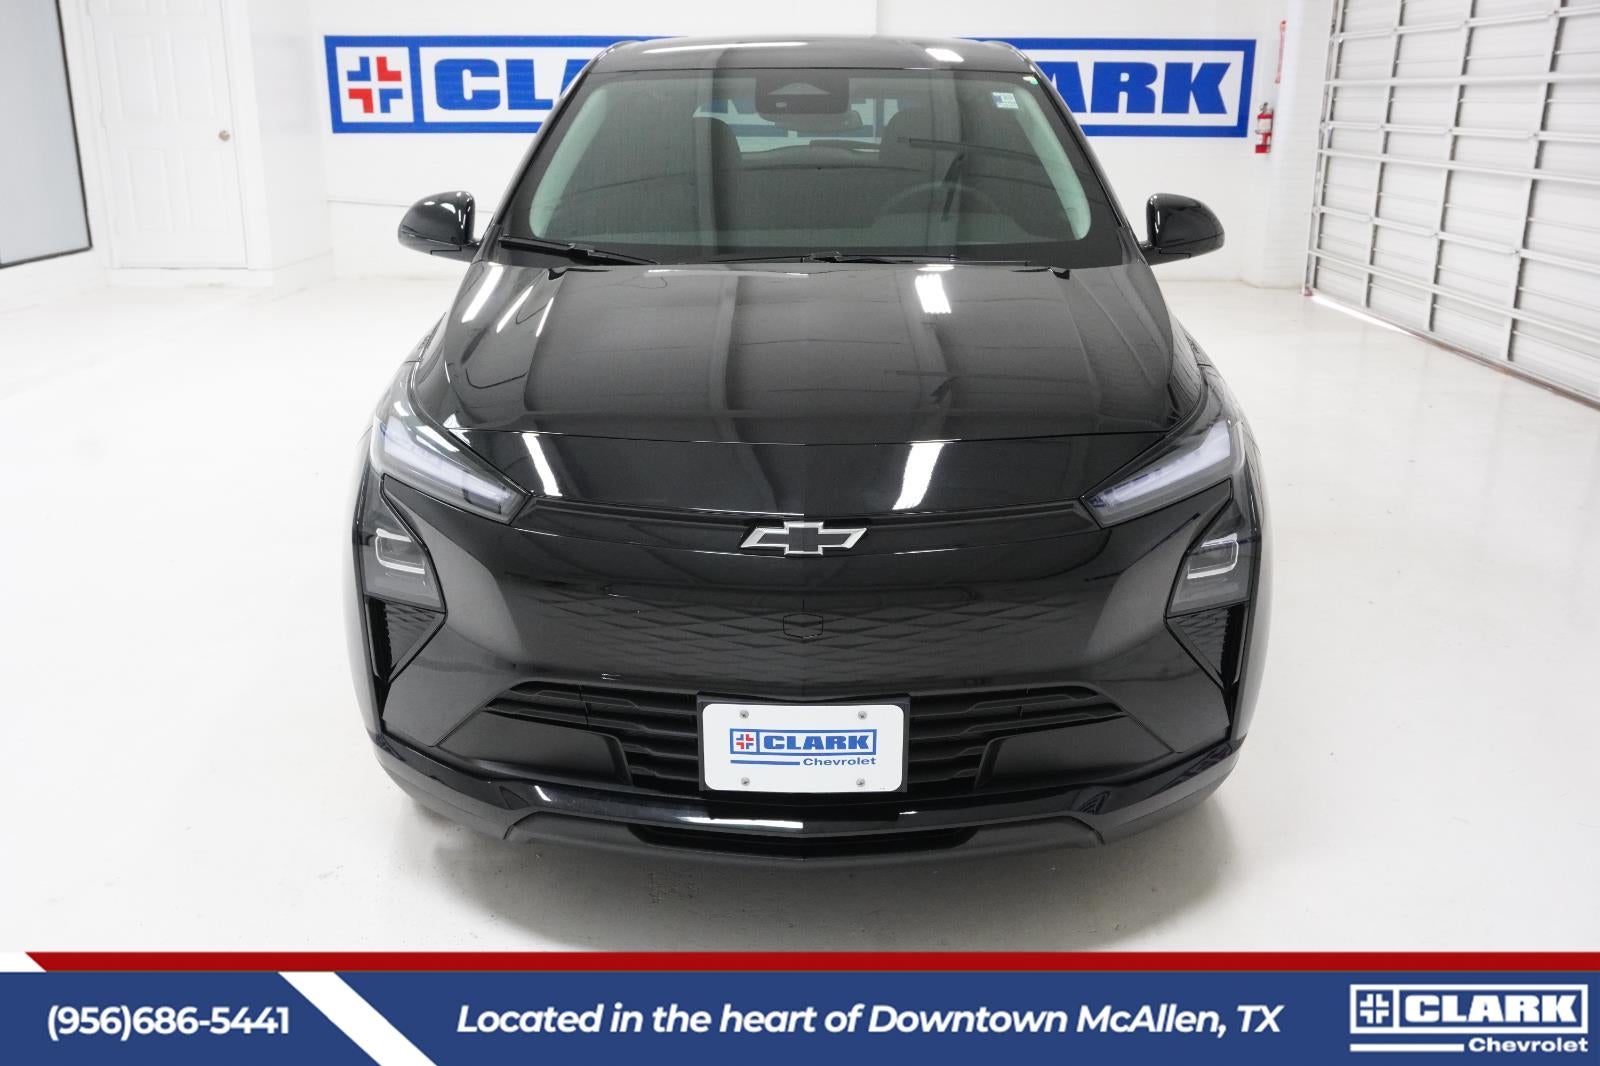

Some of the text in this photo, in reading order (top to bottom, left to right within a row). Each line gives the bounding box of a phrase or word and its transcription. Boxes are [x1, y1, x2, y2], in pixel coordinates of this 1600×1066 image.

[434, 58, 593, 111] CL
[763, 735, 869, 750] CLARK
[803, 757, 876, 766] Chevrolet
